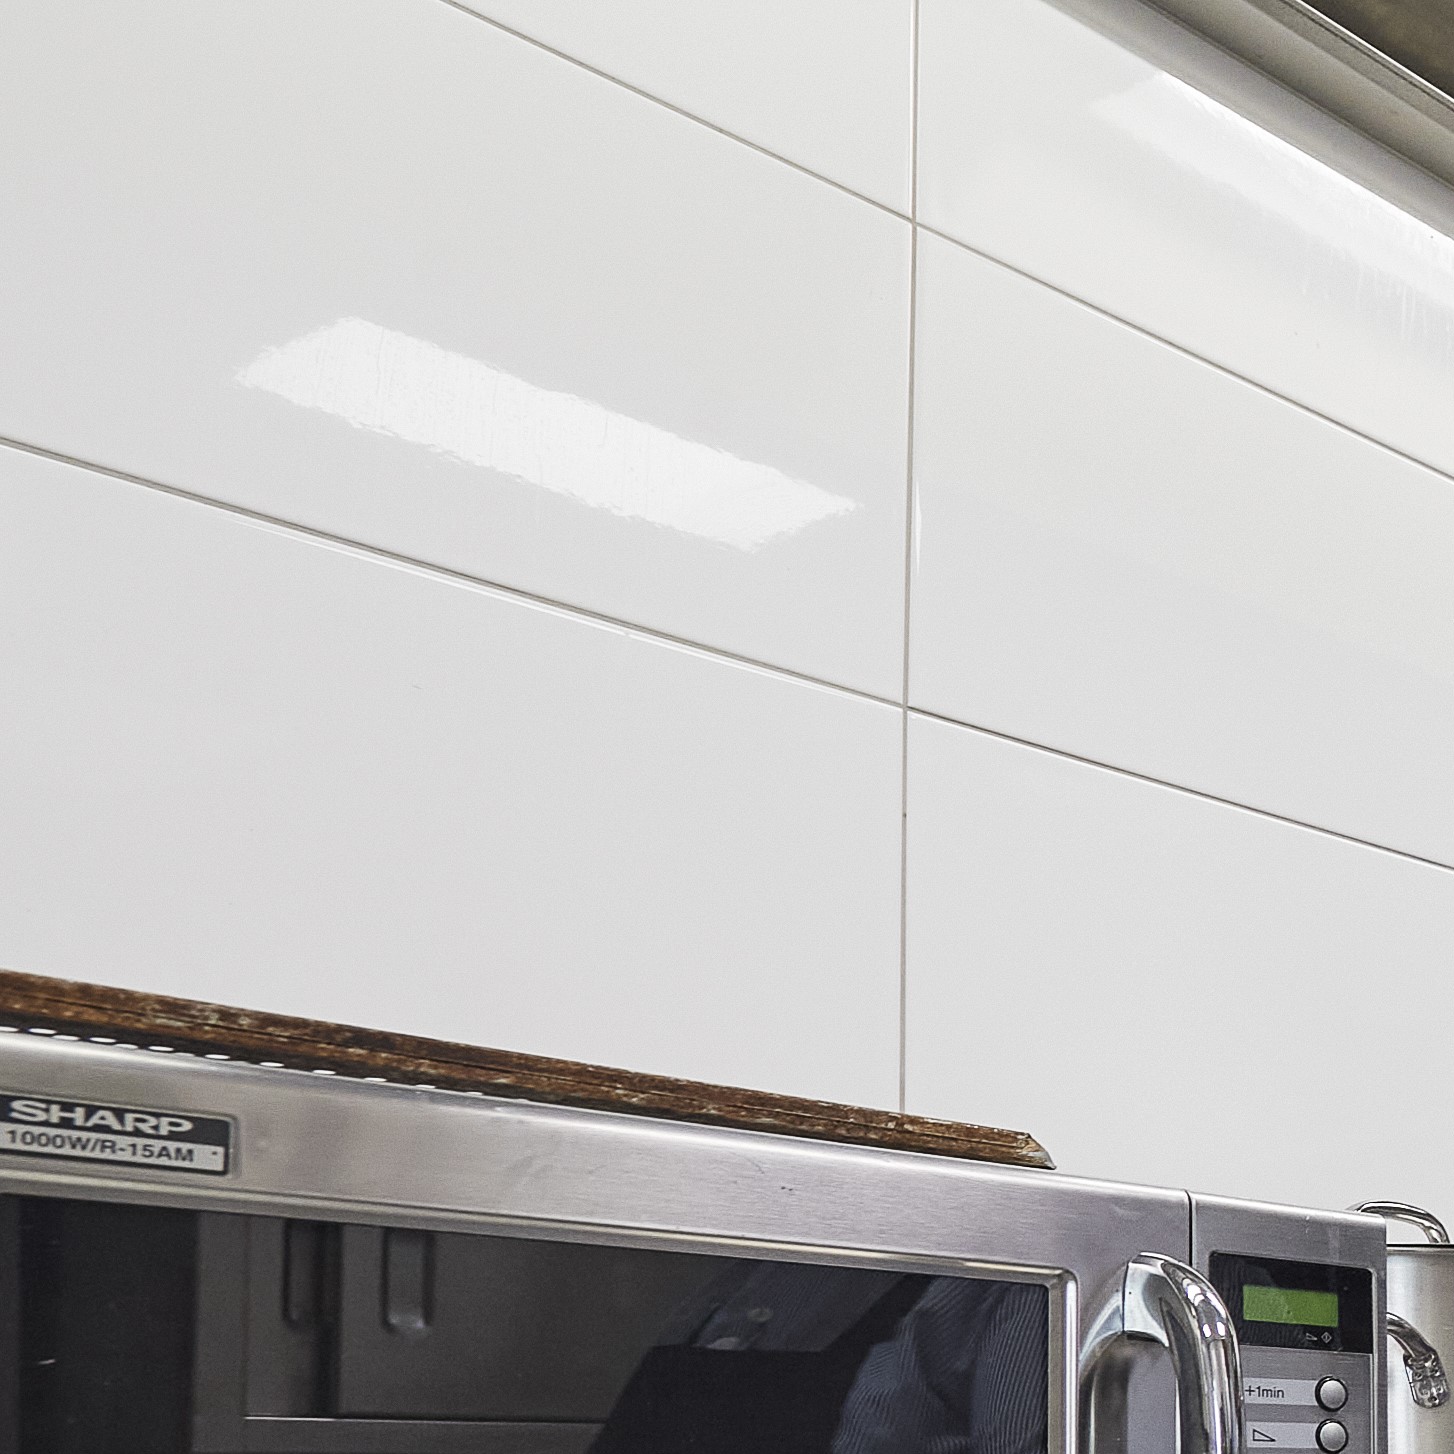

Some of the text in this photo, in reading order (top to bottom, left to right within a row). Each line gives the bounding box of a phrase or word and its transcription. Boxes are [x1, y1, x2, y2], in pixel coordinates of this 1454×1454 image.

[9, 1100, 194, 1136] SHARP
[7, 1130, 195, 1163] 1000W/R-15AM
[1244, 1385, 1285, 1399] +1min
